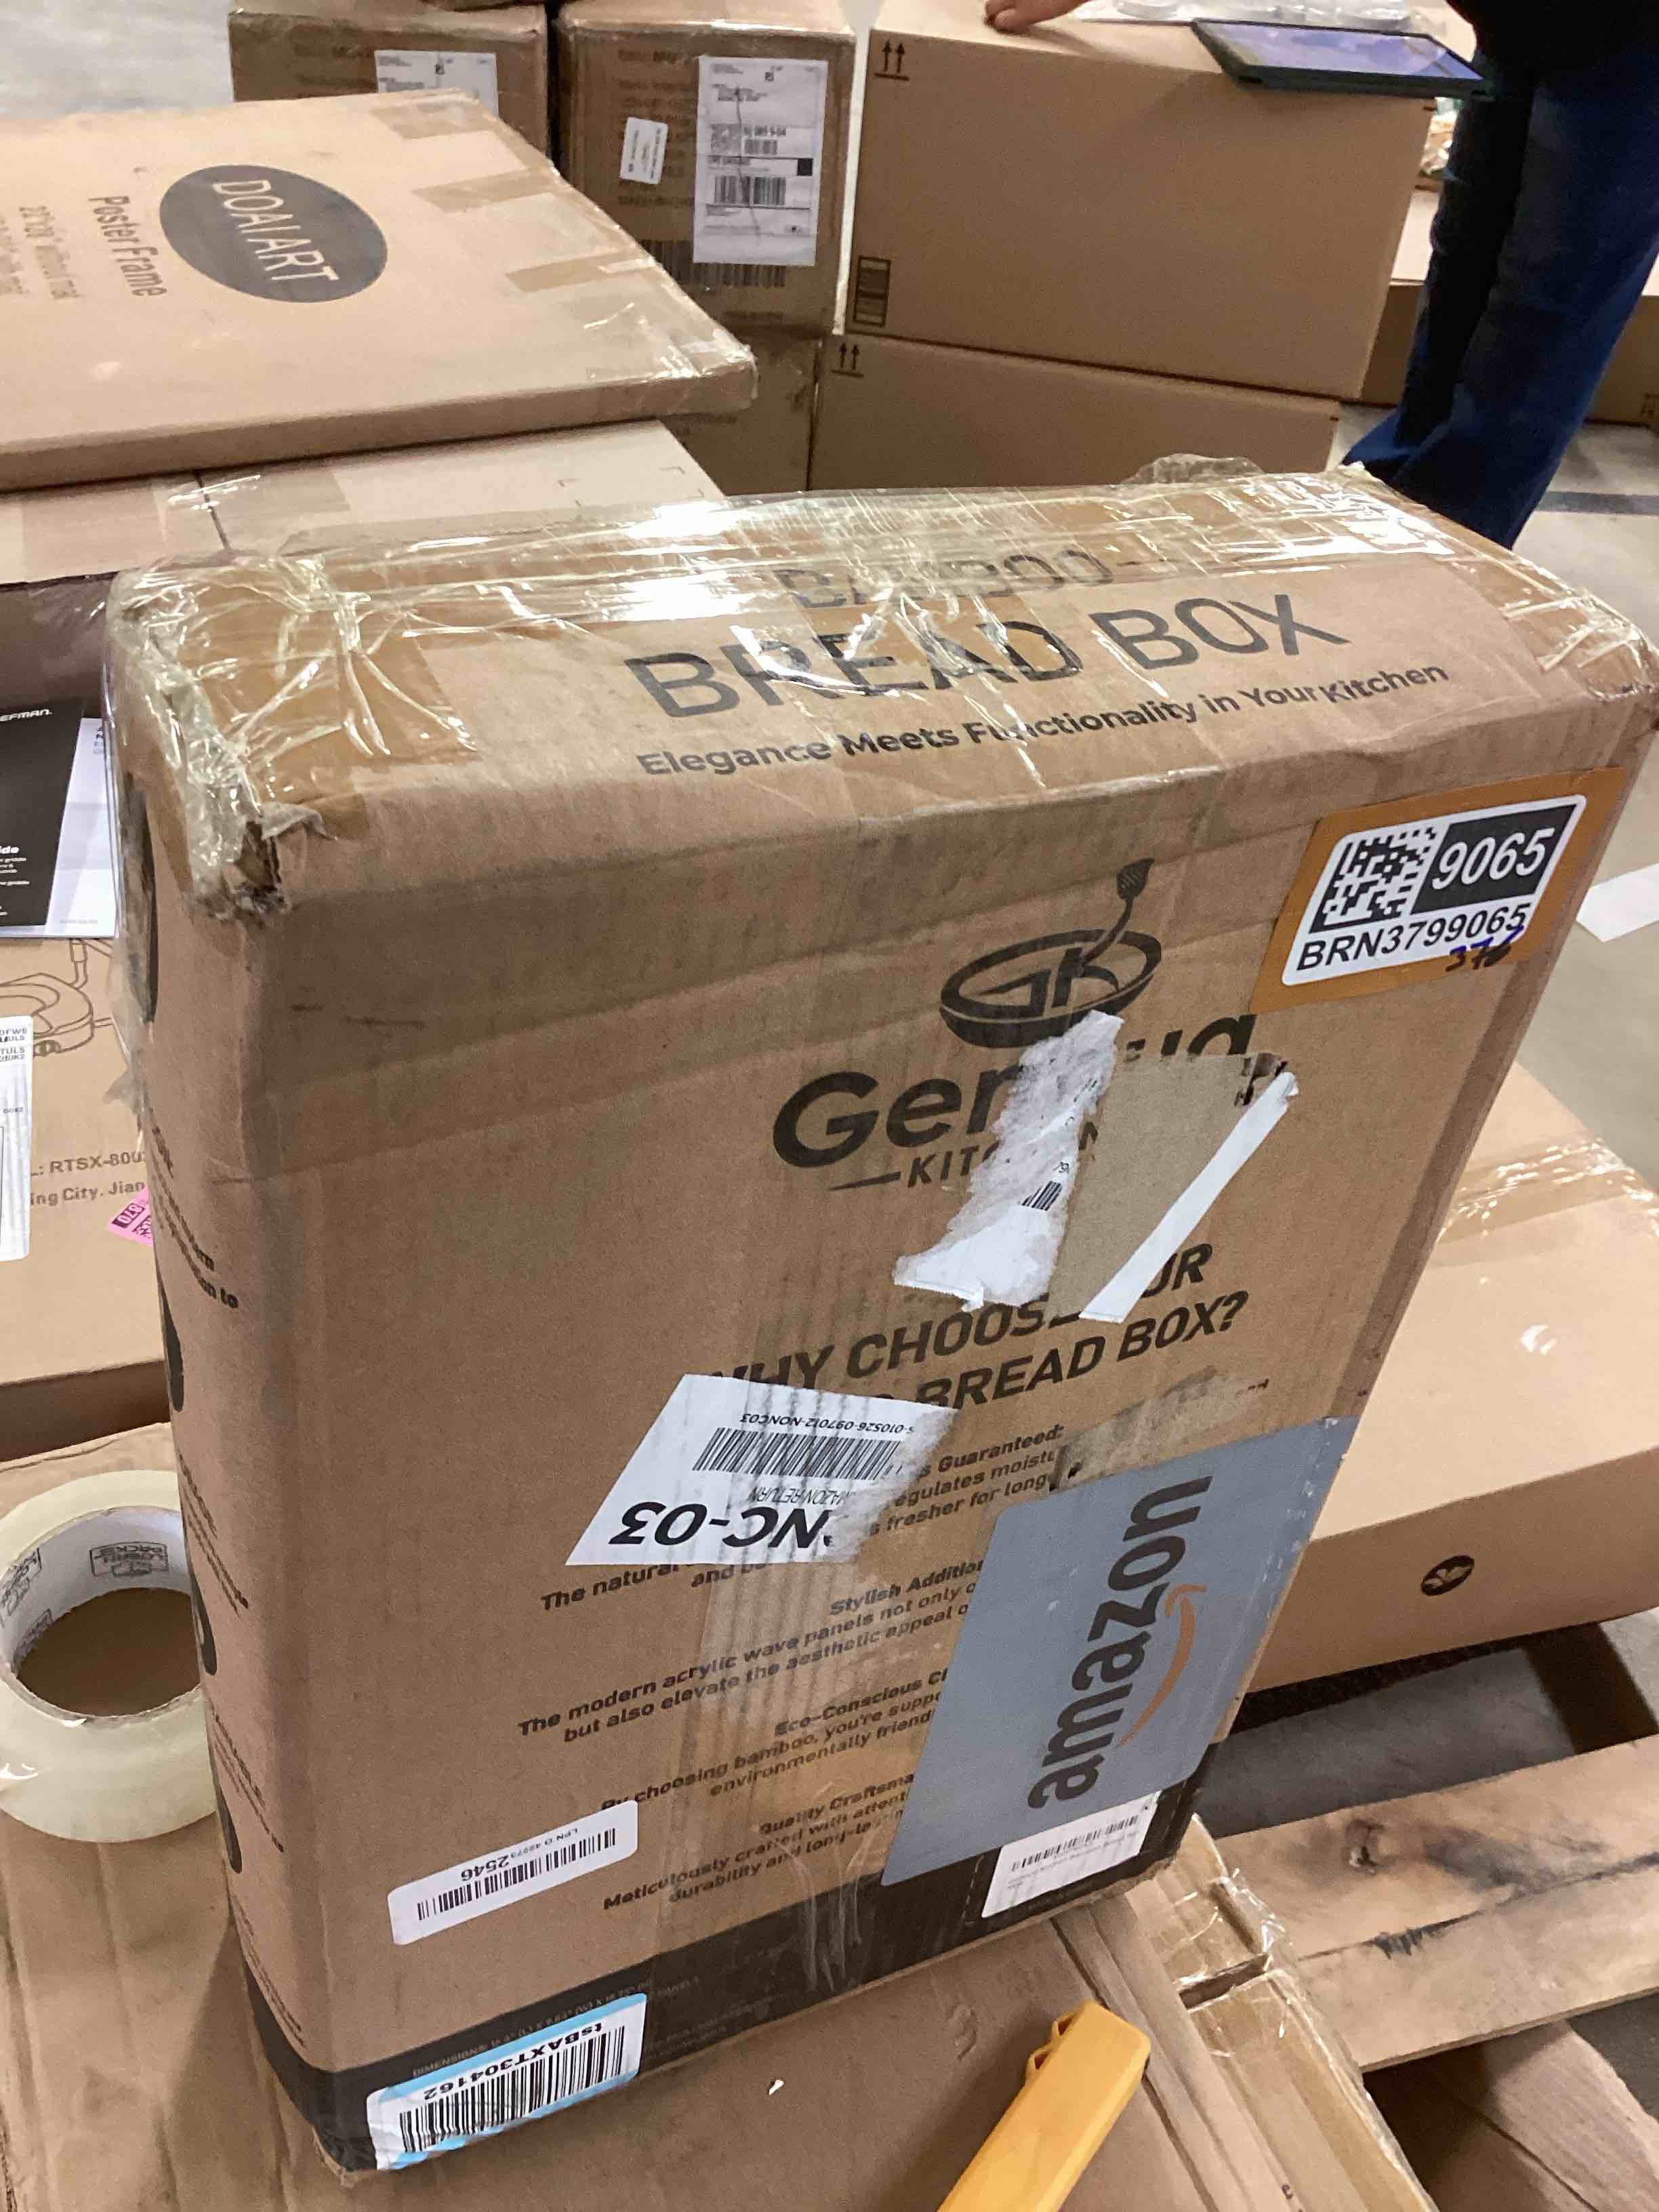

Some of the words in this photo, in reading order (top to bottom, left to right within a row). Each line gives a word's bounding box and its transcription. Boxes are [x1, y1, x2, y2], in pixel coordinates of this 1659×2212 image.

[88, 194, 140, 245] Poster
[112, 245, 167, 297] Frame
[624, 620, 1083, 717] BREAD
[1088, 594, 1351, 670] BOX
[635, 740, 832, 776] Elegance
[838, 724, 960, 757] Meets
[962, 698, 1197, 746] Functionality
[1198, 693, 1241, 715] in
[1237, 684, 1316, 708] Your
[1316, 664, 1450, 704] Kitchen
[1431, 827, 1556, 890] 9065
[1296, 903, 1531, 971] BRN3799065
[845, 1295, 1082, 1380] CHOOS
[915, 1335, 1107, 1409] BREAD
[1117, 1290, 1249, 1361] BOX?
[937, 1423, 1064, 1473] Guaranteed:
[886, 1498, 966, 1532] fresher
[969, 1488, 1002, 1508] for
[894, 1470, 985, 1508] egulates
[609, 1501, 835, 1549] NC-03
[540, 1587, 586, 1611] The
[829, 1582, 901, 1616] Stylish
[518, 1713, 560, 1736] The
[568, 1681, 656, 1721] modern
[662, 1655, 737, 1689] acrylic
[743, 1637, 798, 1662] wave
[803, 1614, 874, 1647] panels
[879, 1600, 912, 1620] not
[918, 1586, 962, 1610] only
[1027, 1475, 1213, 1809] amazon
[564, 1719, 600, 1742] but
[607, 1702, 655, 1728] also
[661, 1675, 740, 1710] elevate
[745, 1663, 780, 1684] the
[786, 1632, 880, 1671] aesthetic
[885, 1606, 951, 1639] appeal
[775, 1677, 922, 1737] Eco-Conscious
[634, 1762, 728, 1803] choosing
[734, 1734, 819, 1771] bamboo,
[824, 1710, 882, 1743] you're
[710, 1731, 871, 1797] environmentally
[758, 1801, 826, 1835] Quality
[461, 1854, 510, 1882] 2546
[604, 1853, 729, 1910] Meticulously
[735, 1825, 804, 1863] crafted
[808, 1810, 848, 1835] with
[668, 1860, 762, 1905] durability
[424, 2022, 603, 2101] tsBAXT304162
